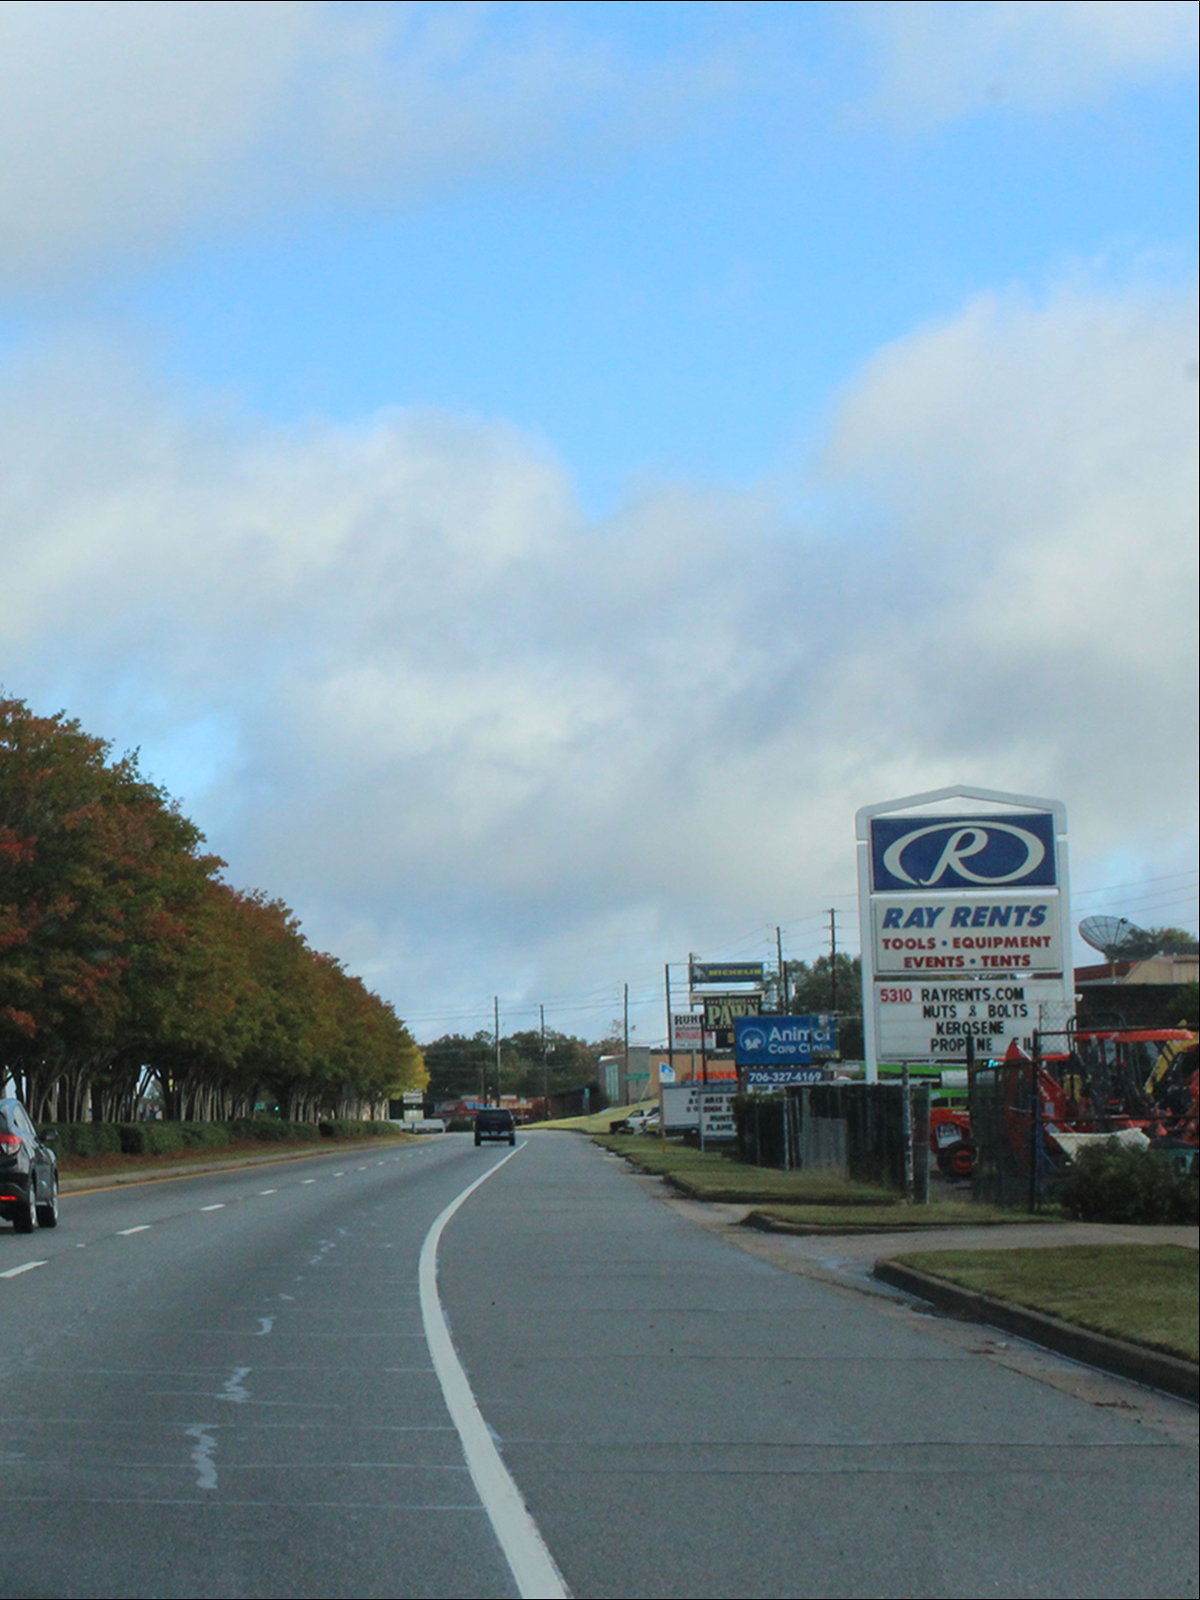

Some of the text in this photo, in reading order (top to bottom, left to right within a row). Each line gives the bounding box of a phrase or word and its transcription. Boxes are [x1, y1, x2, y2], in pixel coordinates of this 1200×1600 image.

[882, 905, 1048, 929] RAY RENTS
[882, 935, 1051, 950] TOOLS EQUIPMENT
[904, 954, 1031, 968] EVENTS TENTS
[708, 968, 762, 976] MICHELIN
[880, 987, 1025, 1003] 5310 RAYRENTS.COM
[707, 1004, 759, 1026] PAWN
[923, 1003, 1028, 1019] NUTS & BOLTS
[936, 1021, 1004, 1035] KEROSENE
[768, 1043, 831, 1054] Care Clni
[931, 1037, 992, 1052] PROPNE
[749, 1071, 822, 1082] 706-327-4169
